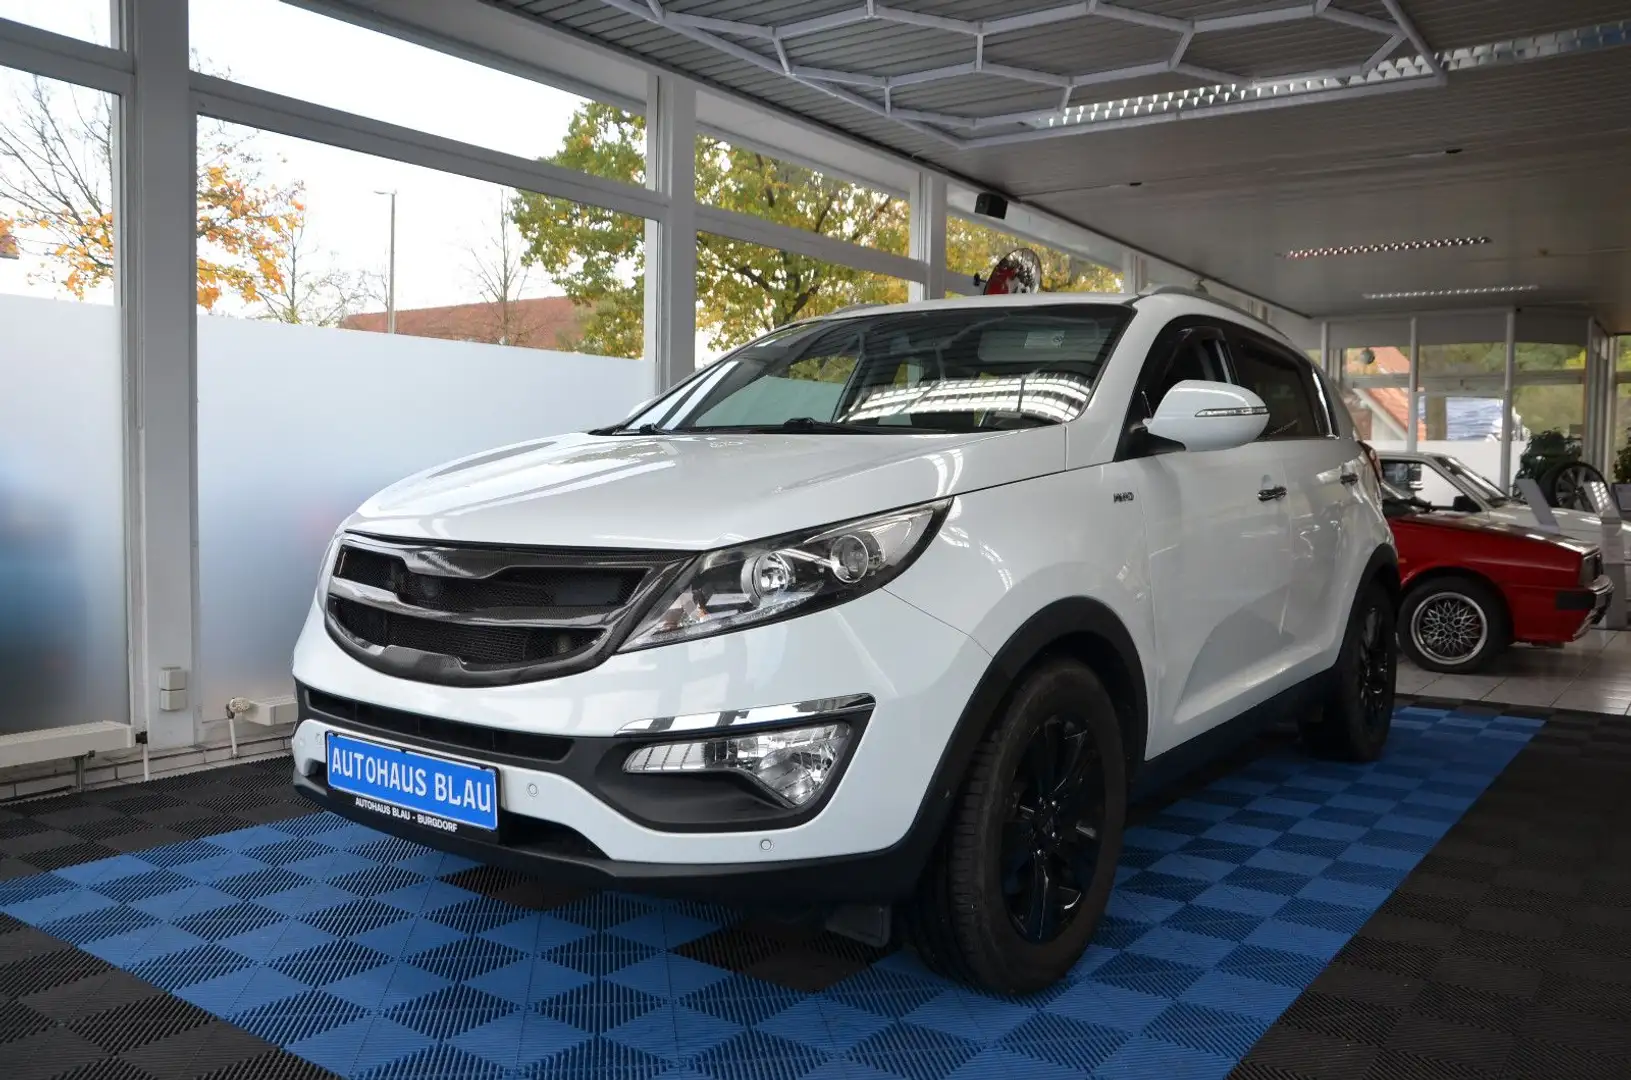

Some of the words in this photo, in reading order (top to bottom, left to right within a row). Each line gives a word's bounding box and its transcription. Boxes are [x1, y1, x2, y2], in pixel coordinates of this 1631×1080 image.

[331, 747, 427, 796] AUTOHAUS
[434, 772, 491, 813] BLAU
[355, 797, 391, 815] AUTOHAUS
[392, 807, 411, 821] BLAU
[417, 814, 458, 833] BURGDORF
